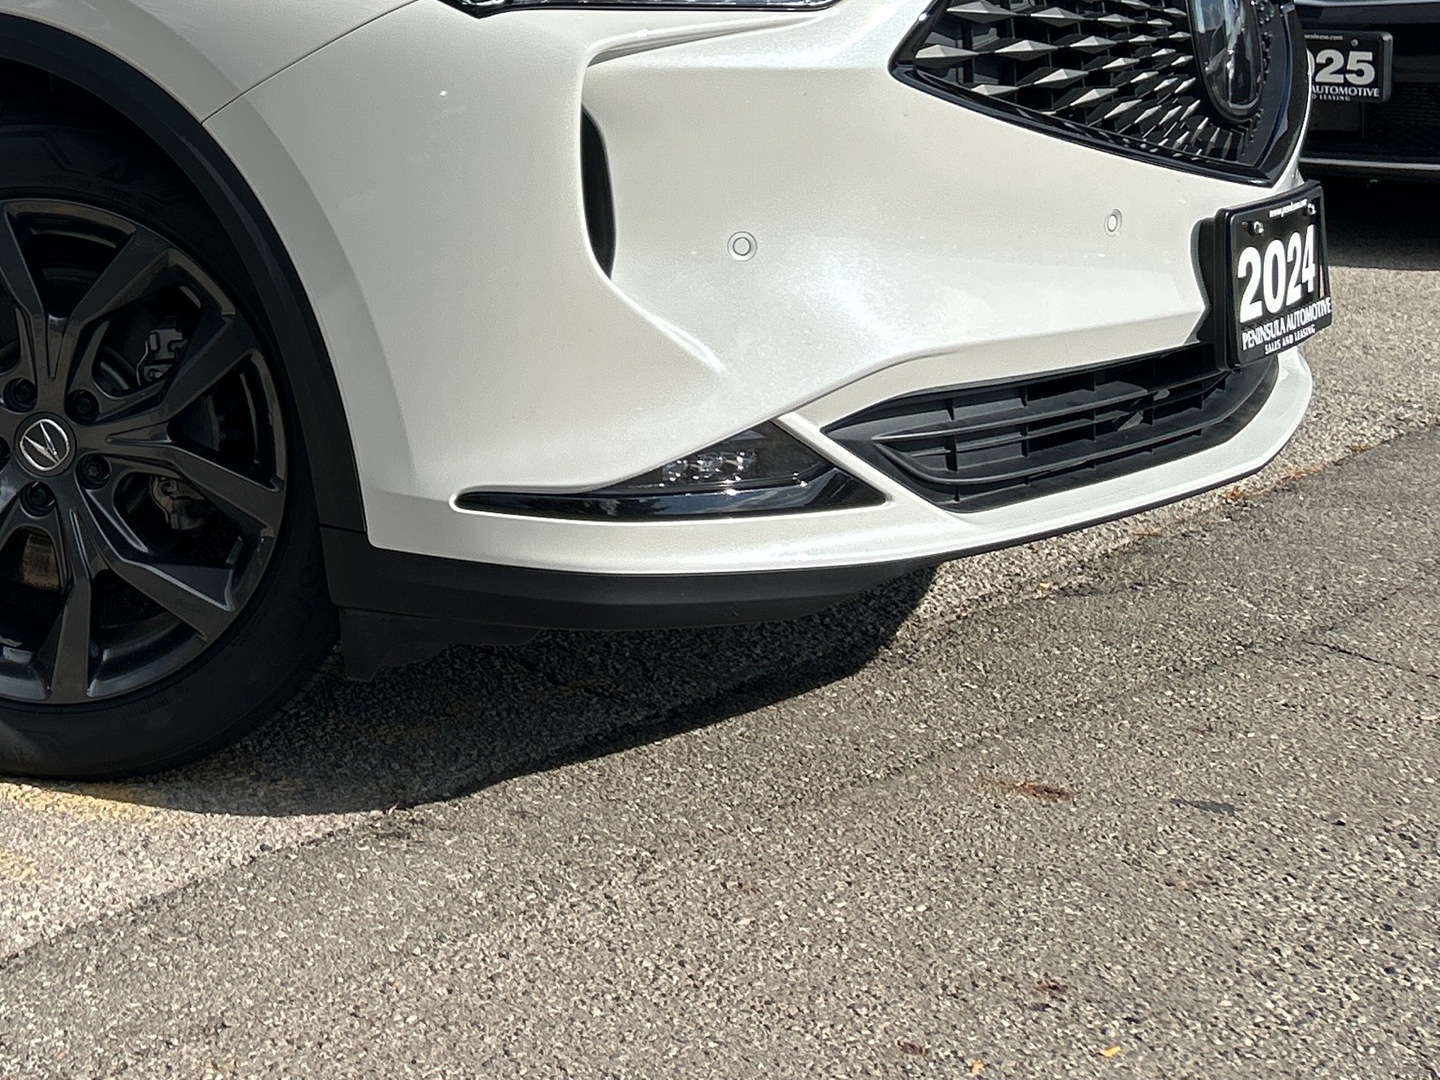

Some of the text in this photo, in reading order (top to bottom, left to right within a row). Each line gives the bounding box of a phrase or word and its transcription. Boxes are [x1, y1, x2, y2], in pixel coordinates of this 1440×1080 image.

[1307, 49, 1376, 86] 25
[1238, 224, 1316, 324] 2024
[1241, 296, 1332, 351] PENINSULA AUTOMOTIVE
[1264, 323, 1316, 355] SALES AND LEASING
